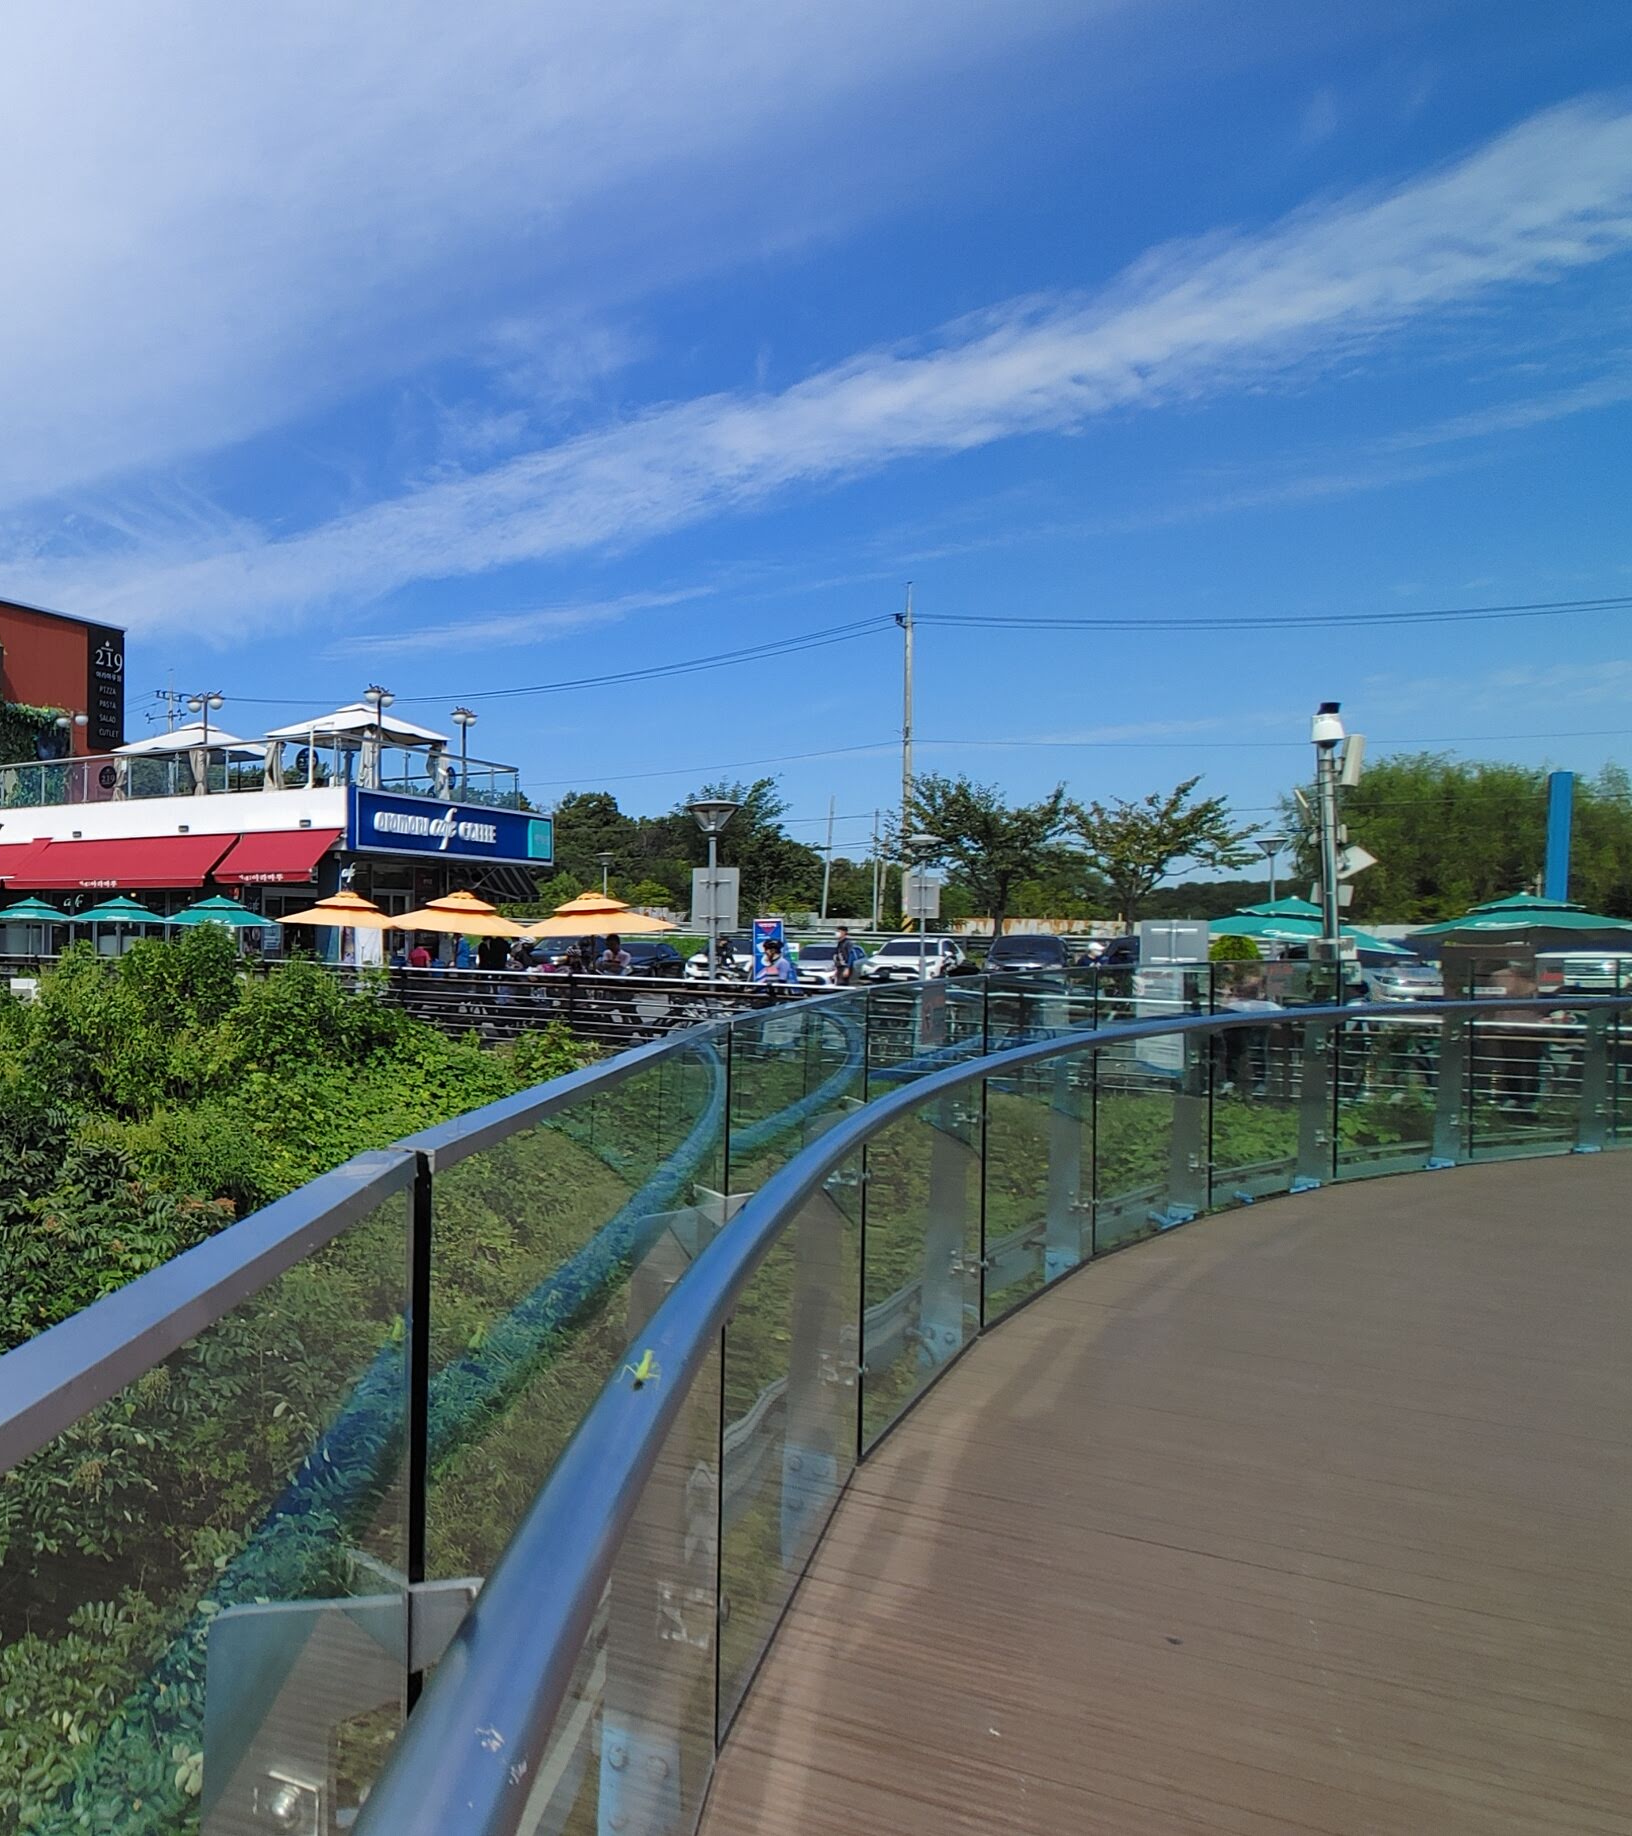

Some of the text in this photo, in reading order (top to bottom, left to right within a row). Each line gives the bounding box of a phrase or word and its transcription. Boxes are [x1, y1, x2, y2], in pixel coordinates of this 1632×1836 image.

[95, 649, 123, 673] 219
[99, 685, 117, 695] PIZZA
[99, 700, 117, 710] PASTA
[99, 714, 117, 724] SALAD
[98, 728, 119, 738] CUTLET
